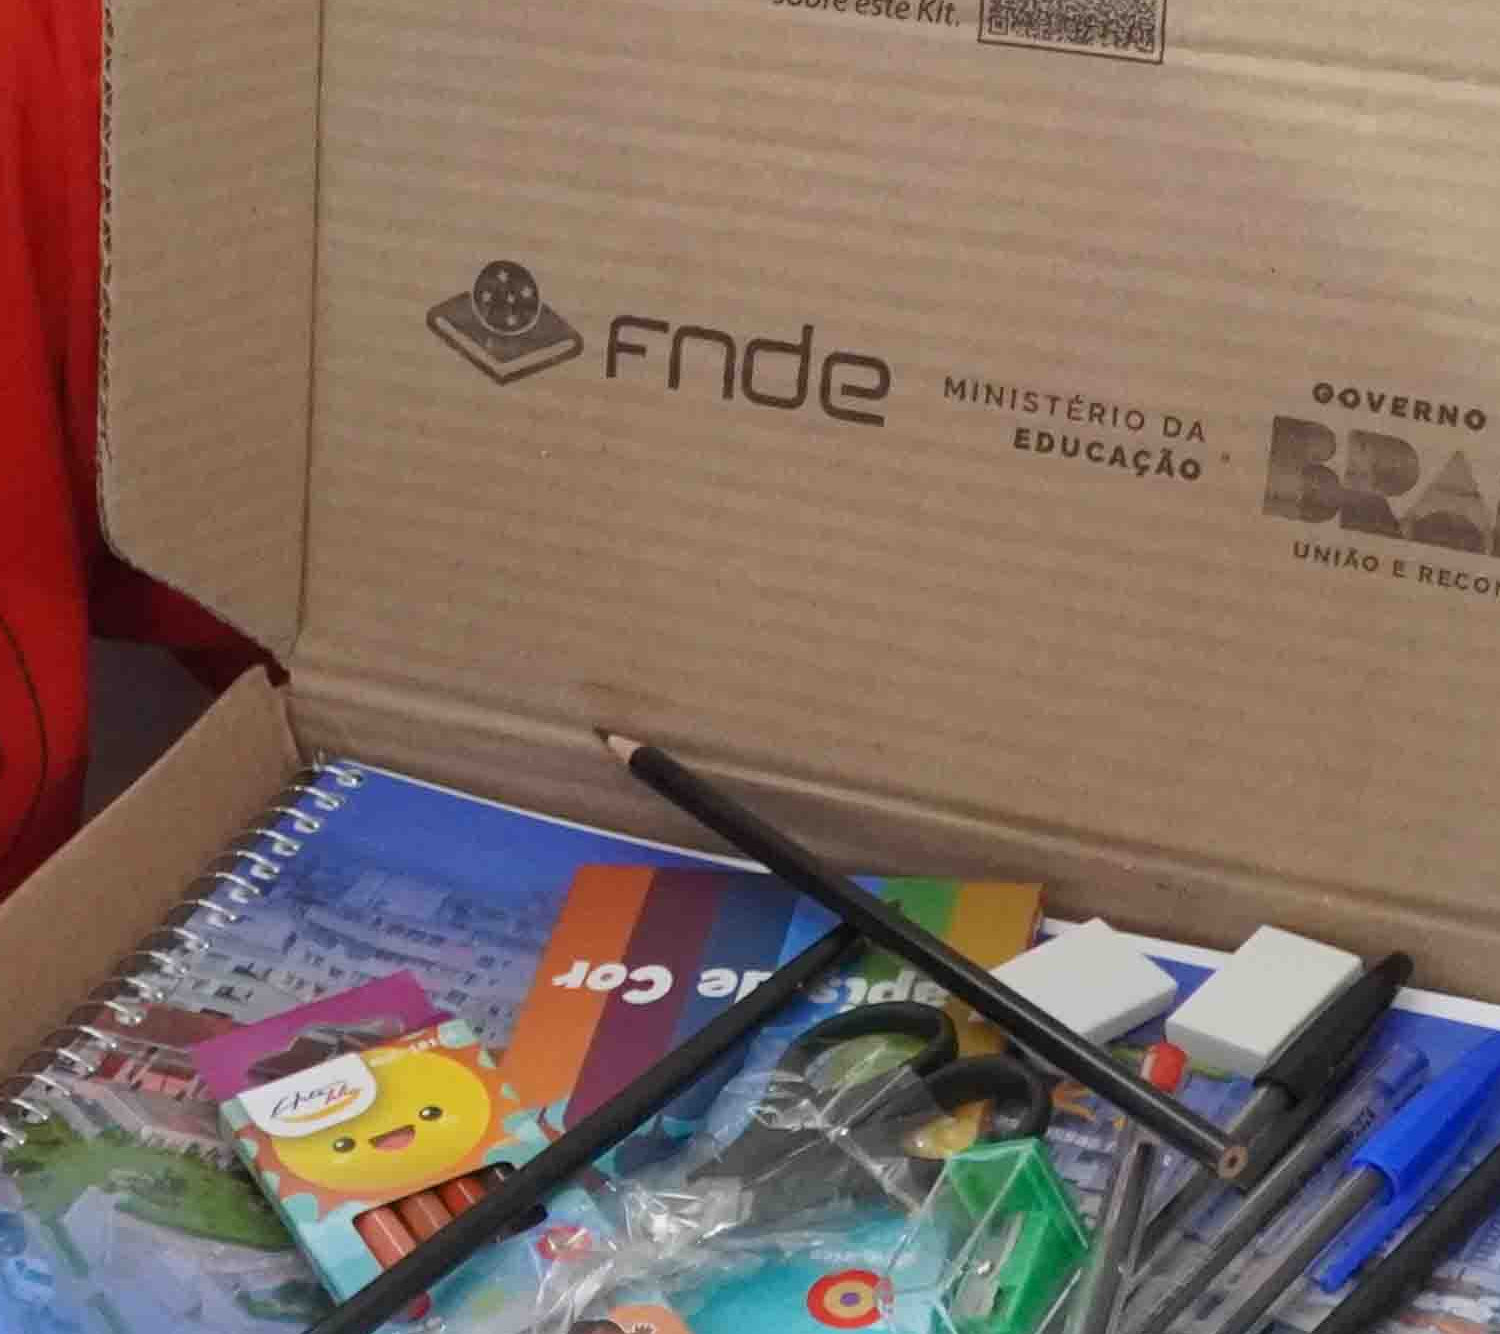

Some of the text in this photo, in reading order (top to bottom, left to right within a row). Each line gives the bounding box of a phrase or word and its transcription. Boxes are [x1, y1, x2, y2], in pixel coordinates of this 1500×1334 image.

[943, 374, 1207, 444] MINISTÉRIO DA
[1311, 380, 1488, 432] GOVERNO
[1012, 427, 1203, 482] EDUCAÇÃO
[1292, 541, 1379, 574] UNIÃO
[1390, 557, 1408, 578] E
[551, 959, 674, 1006] Cor
